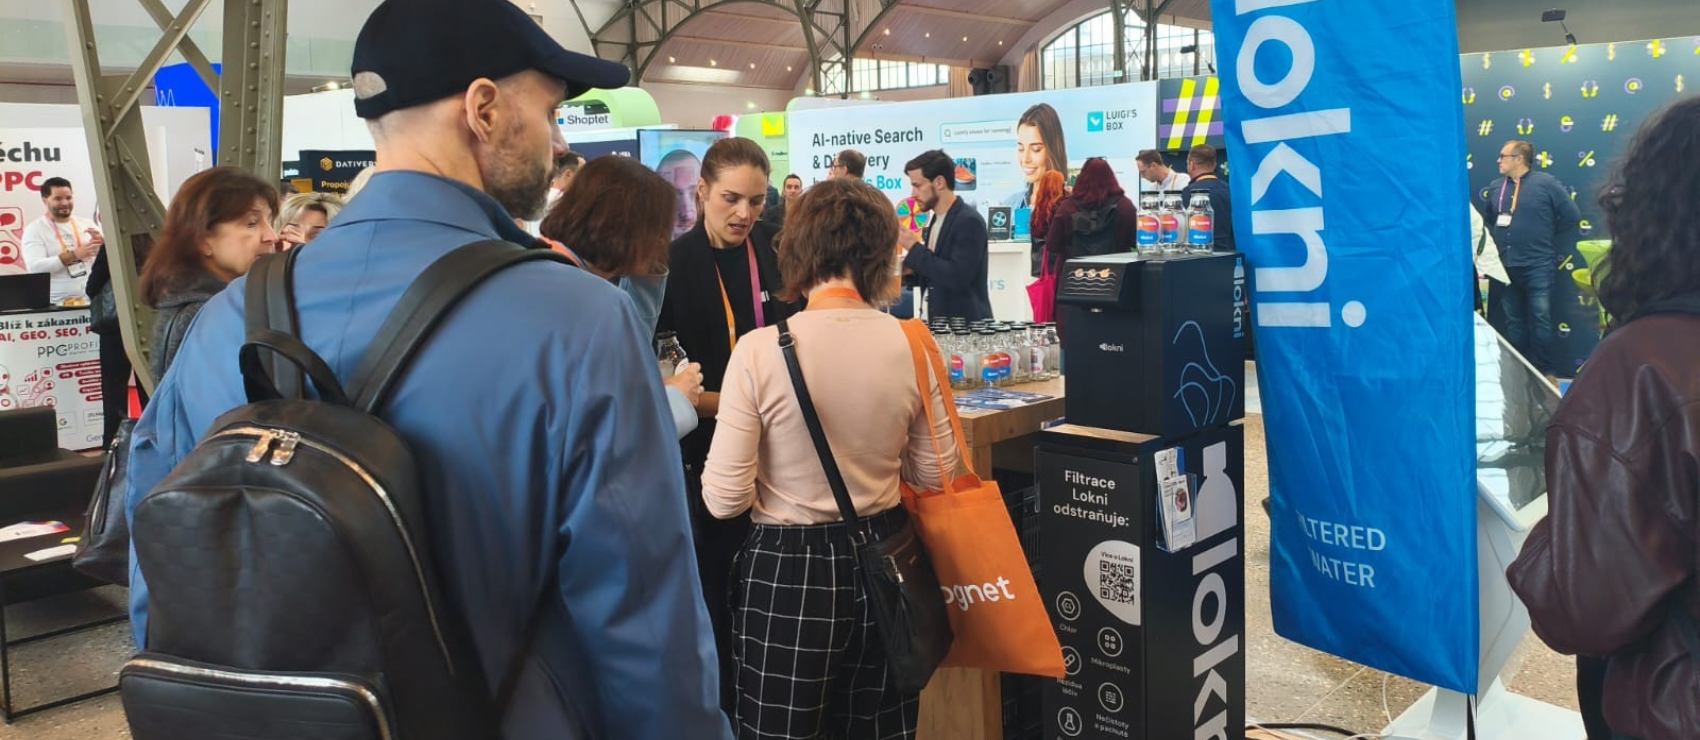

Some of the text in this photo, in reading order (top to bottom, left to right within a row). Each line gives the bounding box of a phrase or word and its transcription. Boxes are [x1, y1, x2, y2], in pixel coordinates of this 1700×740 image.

[567, 112, 609, 125] Shoptet
[1106, 109, 1137, 120] LUIGI'S
[1106, 121, 1123, 131] BOX
[812, 126, 923, 147] AI-native Search
[812, 155, 820, 169] &
[1235, 0, 1367, 328] okni
[0, 170, 43, 192] PC
[876, 175, 902, 190] Box
[1233, 279, 1245, 338] lokni
[25, 319, 33, 329] k
[20, 329, 51, 341] GEO,
[55, 327, 81, 338] SEO,
[1064, 469, 1116, 490] Filtrace
[1072, 487, 1108, 506] Lokni
[1053, 503, 1130, 528] odstraňuje:
[940, 576, 1016, 612] ognet
